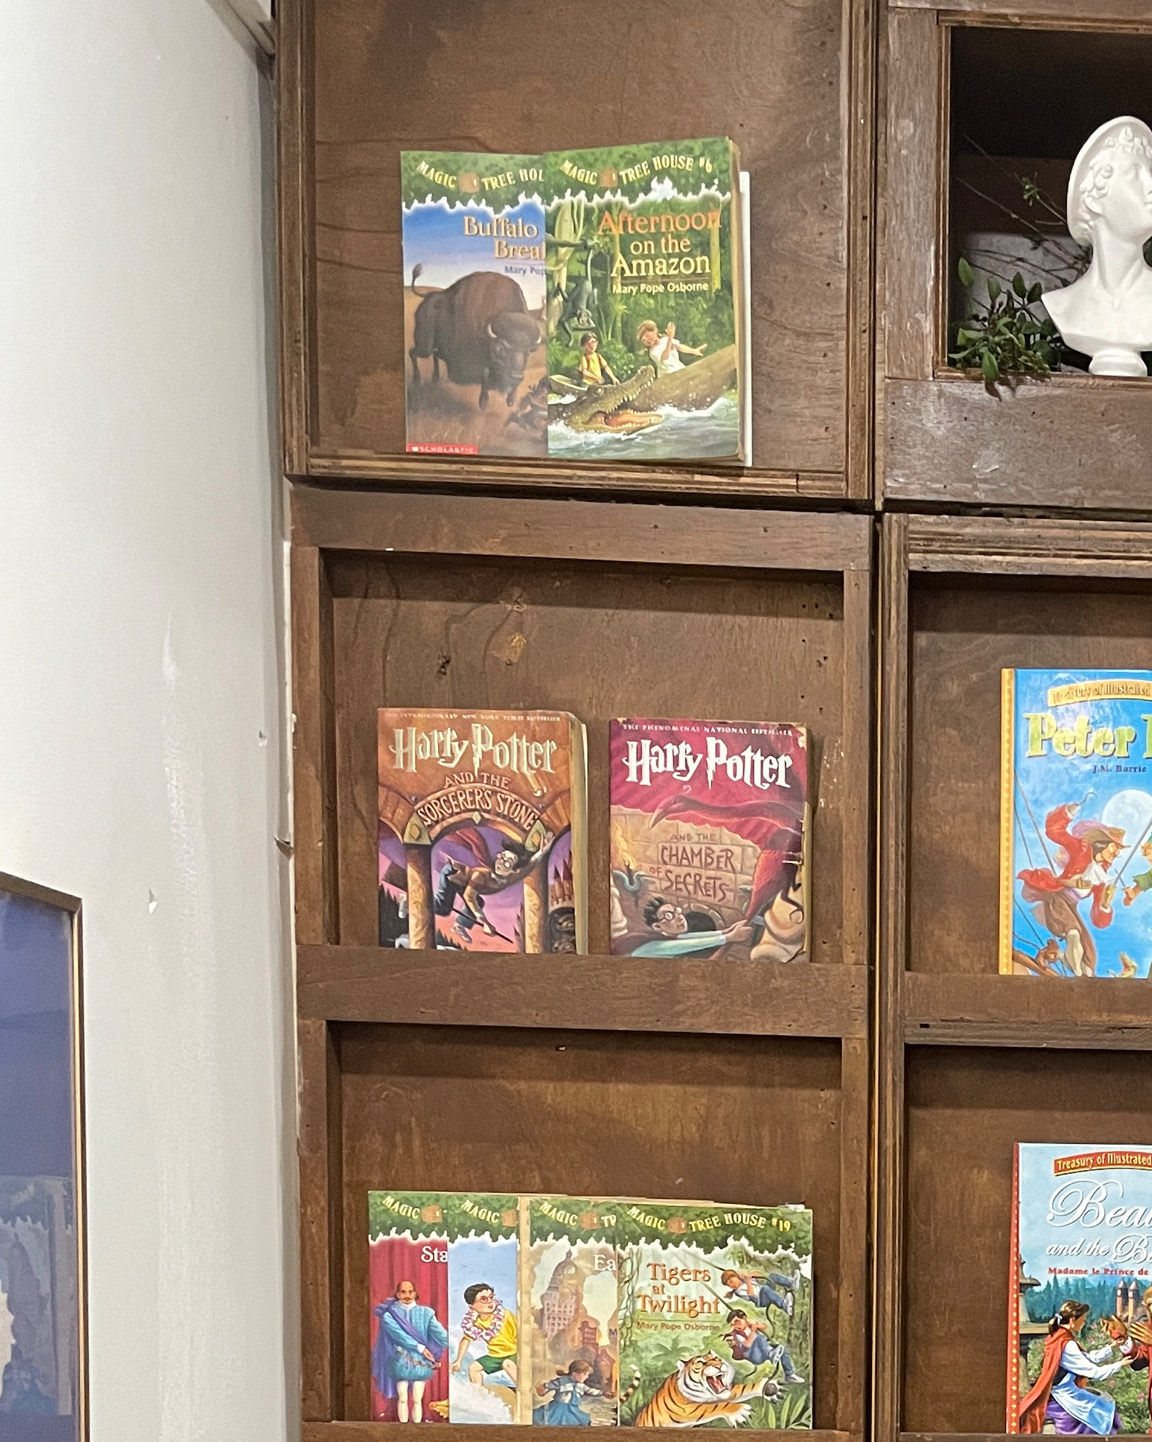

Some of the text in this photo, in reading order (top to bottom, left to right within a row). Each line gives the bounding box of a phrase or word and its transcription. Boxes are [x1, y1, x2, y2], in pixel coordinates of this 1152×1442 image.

[464, 216, 538, 238] Buffalo
[597, 209, 721, 236] Afternoon
[630, 233, 691, 255] on the
[611, 254, 710, 278] Amazon
[418, 444, 475, 454] SCHOLASTIC
[1023, 712, 1138, 759] Peter
[389, 723, 557, 777] Harry Potter
[622, 736, 793, 790] Harry Potter
[443, 772, 511, 789] AND THE
[417, 788, 538, 830] SORCERER'S STONE
[660, 846, 735, 873] CHAMBER
[664, 870, 729, 902] SECRETS
[1057, 1156, 1094, 1172] Treasury
[1097, 1154, 1105, 1166] of
[1108, 1153, 1152, 1166] Illustrated
[626, 1206, 791, 1232] MAGIC TREE HOUSE #19
[646, 1262, 711, 1286] Tigers
[1104, 1268, 1134, 1276] Prince
[1138, 1268, 1148, 1276] de
[636, 1294, 721, 1319] Twilight
